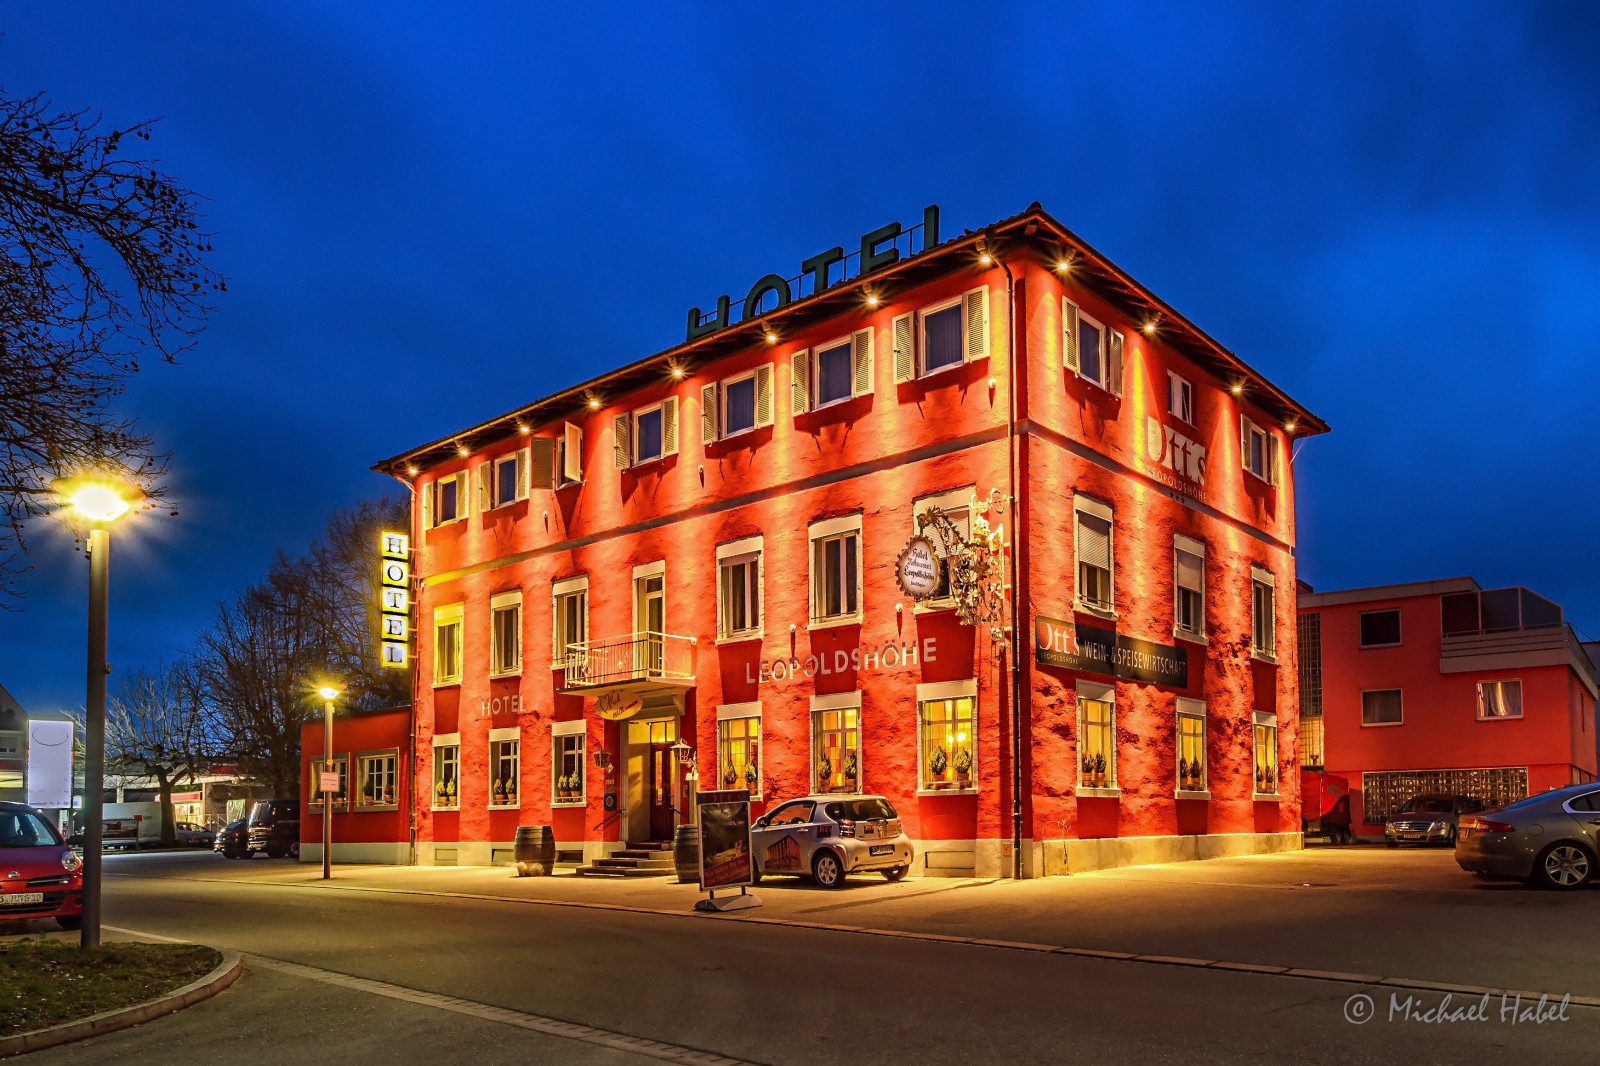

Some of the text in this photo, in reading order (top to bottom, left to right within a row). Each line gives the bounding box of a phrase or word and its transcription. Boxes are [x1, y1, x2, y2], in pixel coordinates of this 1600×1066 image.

[386, 537, 403, 663] HOTEL
[746, 637, 937, 684] LEOPOLDSHÖHE
[1117, 648, 1186, 677] SPEISEWIRTSCHAFT
[481, 695, 526, 716] HOTEL
